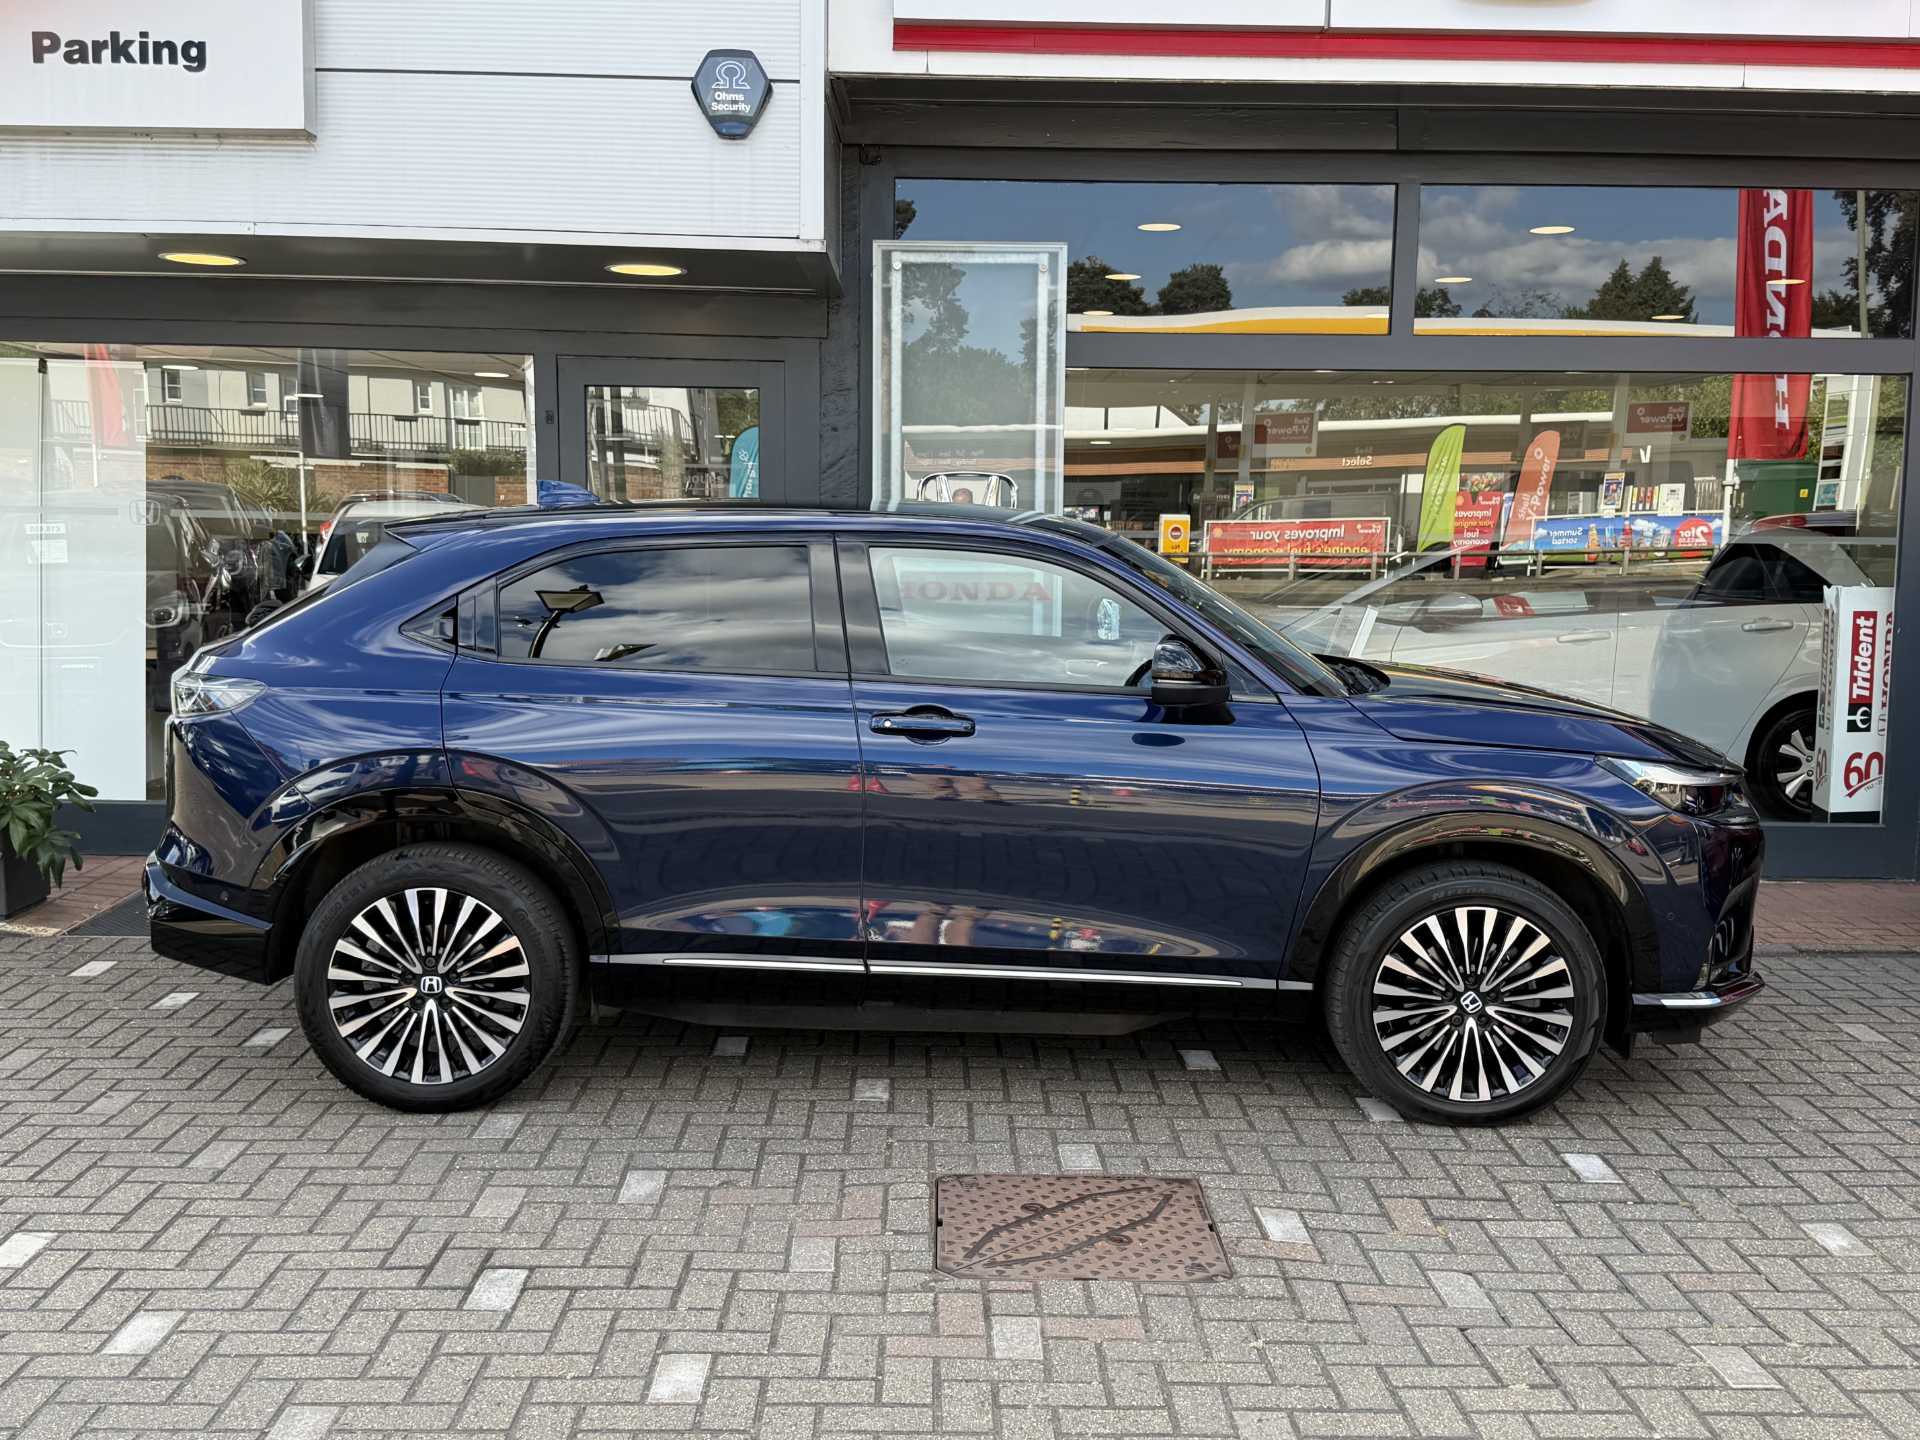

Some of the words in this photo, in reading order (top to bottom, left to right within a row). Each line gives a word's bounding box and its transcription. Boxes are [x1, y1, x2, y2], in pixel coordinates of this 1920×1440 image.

[31, 31, 207, 73] Parking
[711, 102, 751, 113] Security
[714, 91, 745, 101] Ohms
[1526, 455, 1551, 521] V-Power
[1852, 616, 1875, 699] Trident
[1844, 751, 1883, 791] 60
